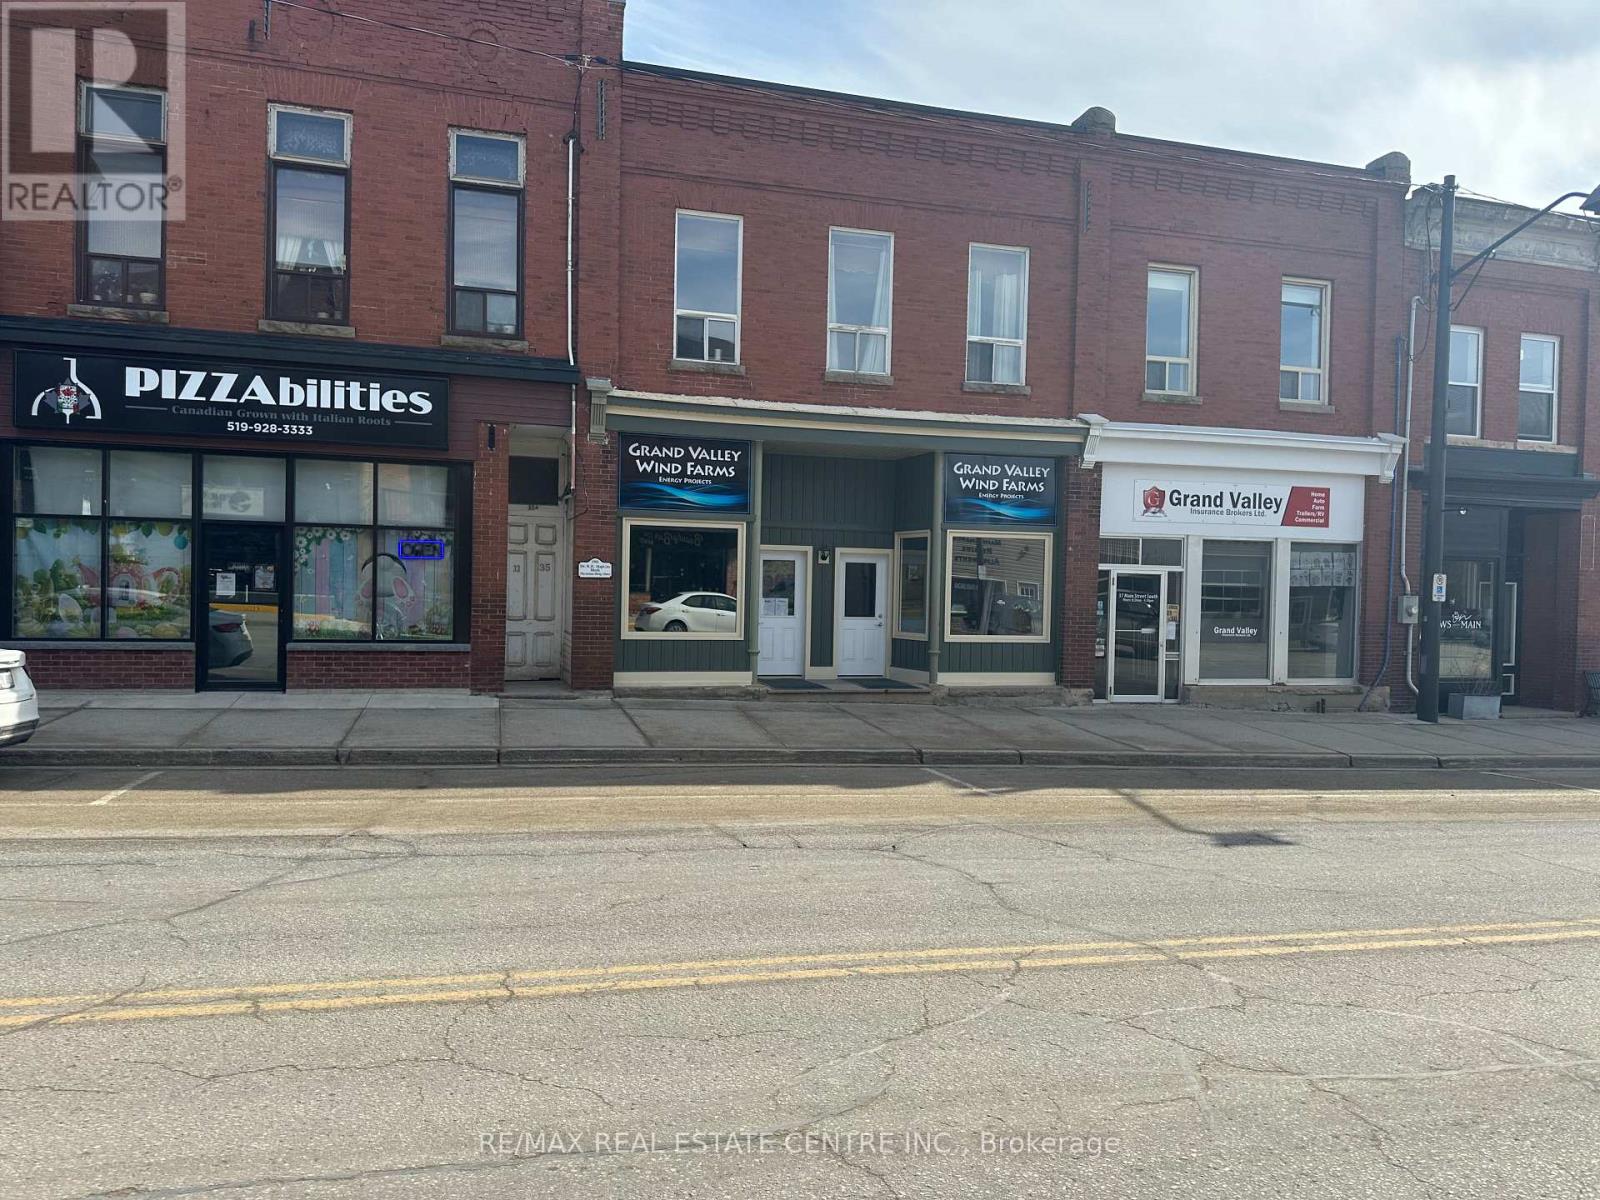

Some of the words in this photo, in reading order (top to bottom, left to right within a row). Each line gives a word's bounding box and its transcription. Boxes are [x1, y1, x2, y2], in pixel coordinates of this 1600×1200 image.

[171, 405, 235, 417] Canadian
[236, 408, 278, 420] Grown
[279, 411, 309, 422] with
[312, 412, 354, 424] Italian
[358, 415, 391, 427] Roots
[227, 421, 313, 436] 519-928-3333
[628, 443, 684, 458] GRAND
[688, 446, 742, 462] VALLEY
[635, 459, 682, 474] WIND
[686, 462, 736, 477] FARMS
[953, 462, 1001, 476] GRAND
[1004, 464, 1050, 478] VALLEY
[659, 476, 683, 484] ENERGY
[684, 477, 712, 485] PROJECTS
[959, 477, 999, 490] WIND
[1002, 478, 1045, 492] FARMS
[1169, 489, 1224, 509] Grand
[1229, 492, 1283, 514] Valley
[1190, 507, 1224, 516] Insurance
[1225, 509, 1253, 517] Brokers
[539, 563, 551, 572] 35
[1213, 627, 1235, 635] Grand
[1236, 627, 1257, 636] Valley
[1460, 620, 1481, 629] MAIN
